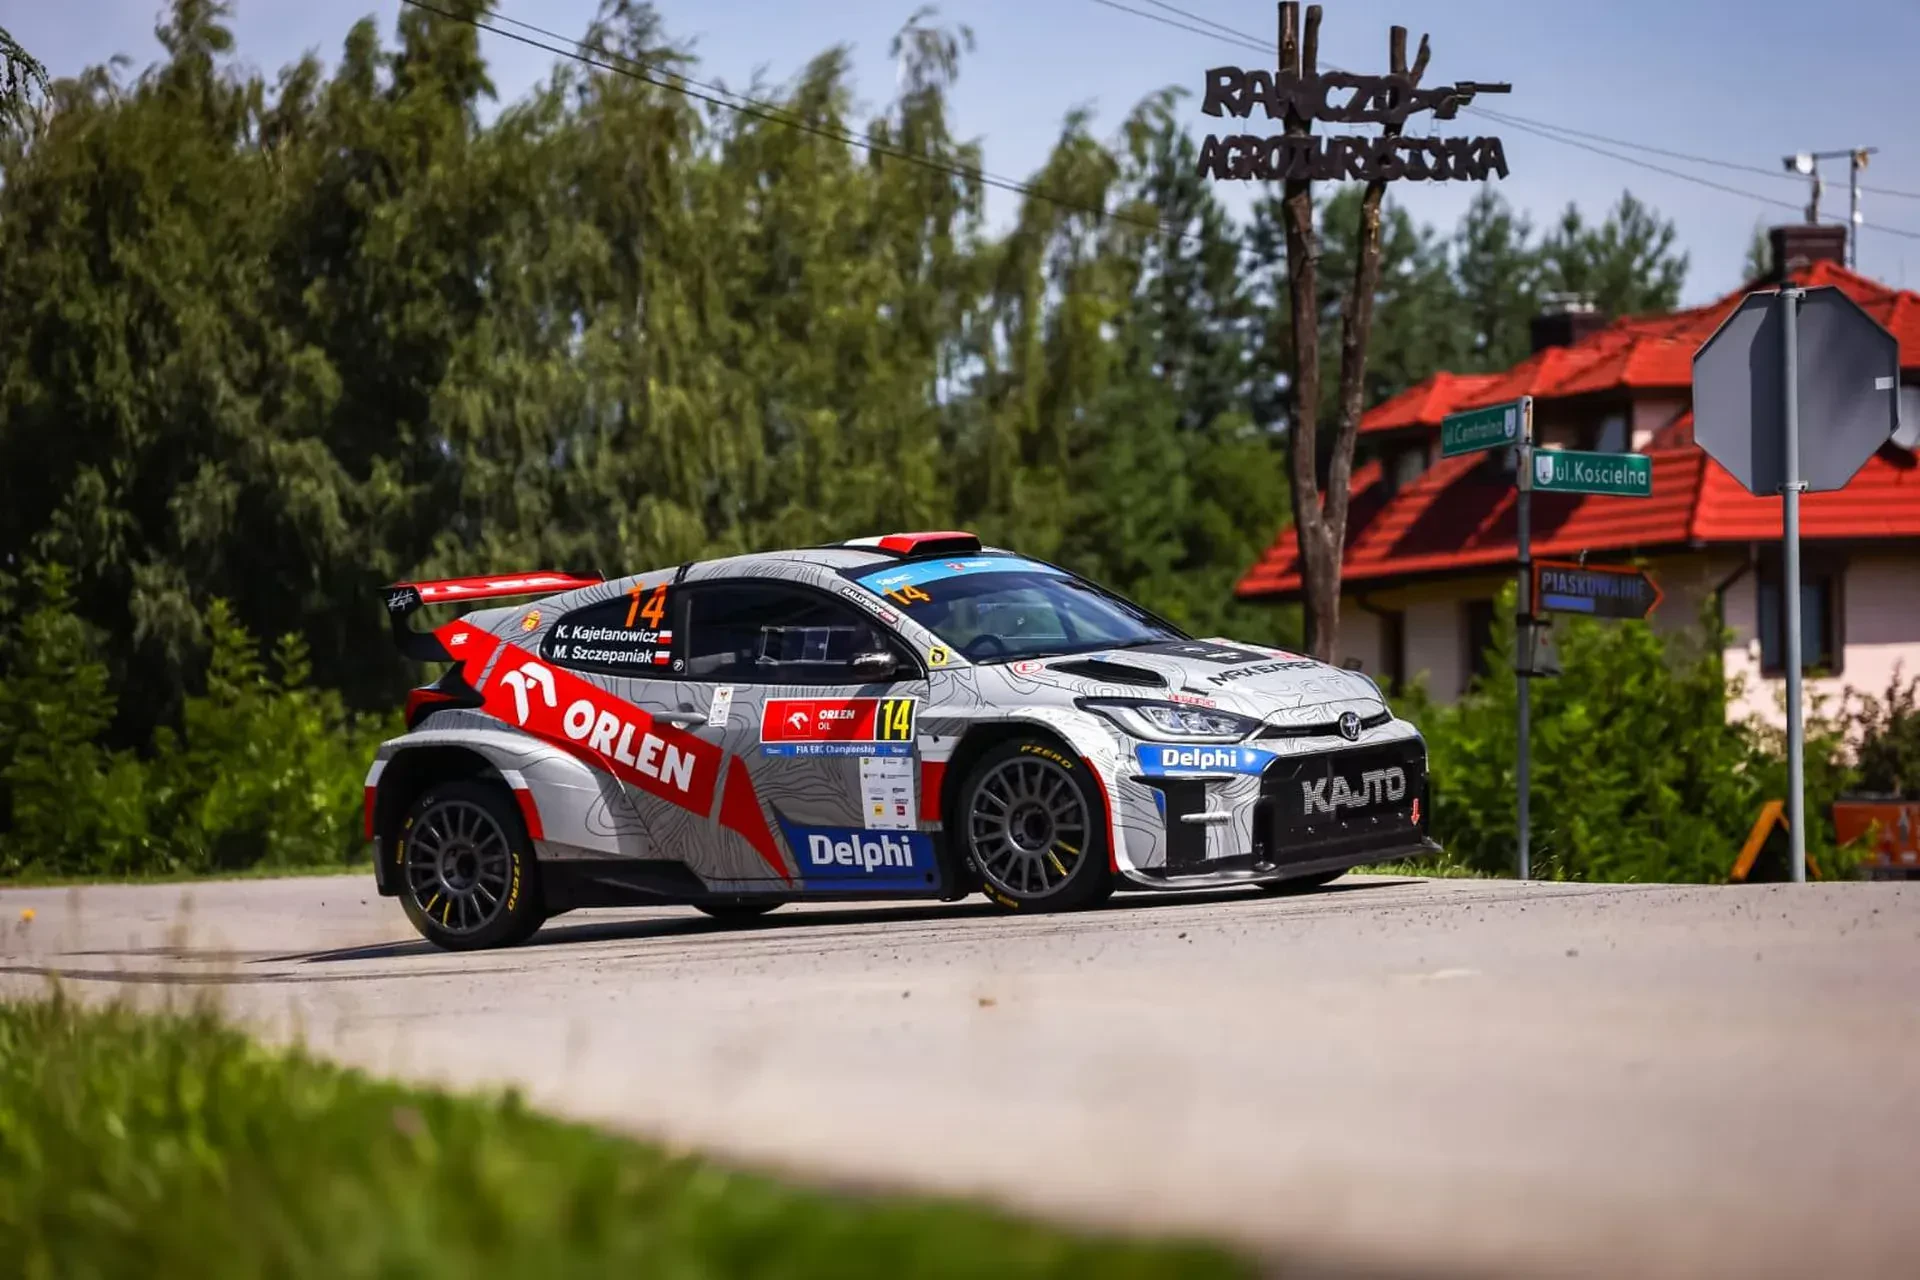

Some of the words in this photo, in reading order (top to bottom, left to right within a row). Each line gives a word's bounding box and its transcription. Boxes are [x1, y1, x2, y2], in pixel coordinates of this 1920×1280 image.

[626, 582, 668, 628] 14
[883, 583, 931, 605] 14
[555, 625, 569, 639] K.
[572, 625, 658, 643] Kajetanowicz
[552, 644, 568, 659] M.
[571, 645, 653, 664] Szczepaniak
[817, 721, 831, 730] OIL
[818, 709, 856, 720] ORLEN
[883, 700, 911, 740] 14
[563, 700, 697, 793] ORLEN
[1162, 748, 1237, 770] Delphi
[1302, 766, 1407, 815] KAJTO
[808, 834, 913, 872] Delphi
